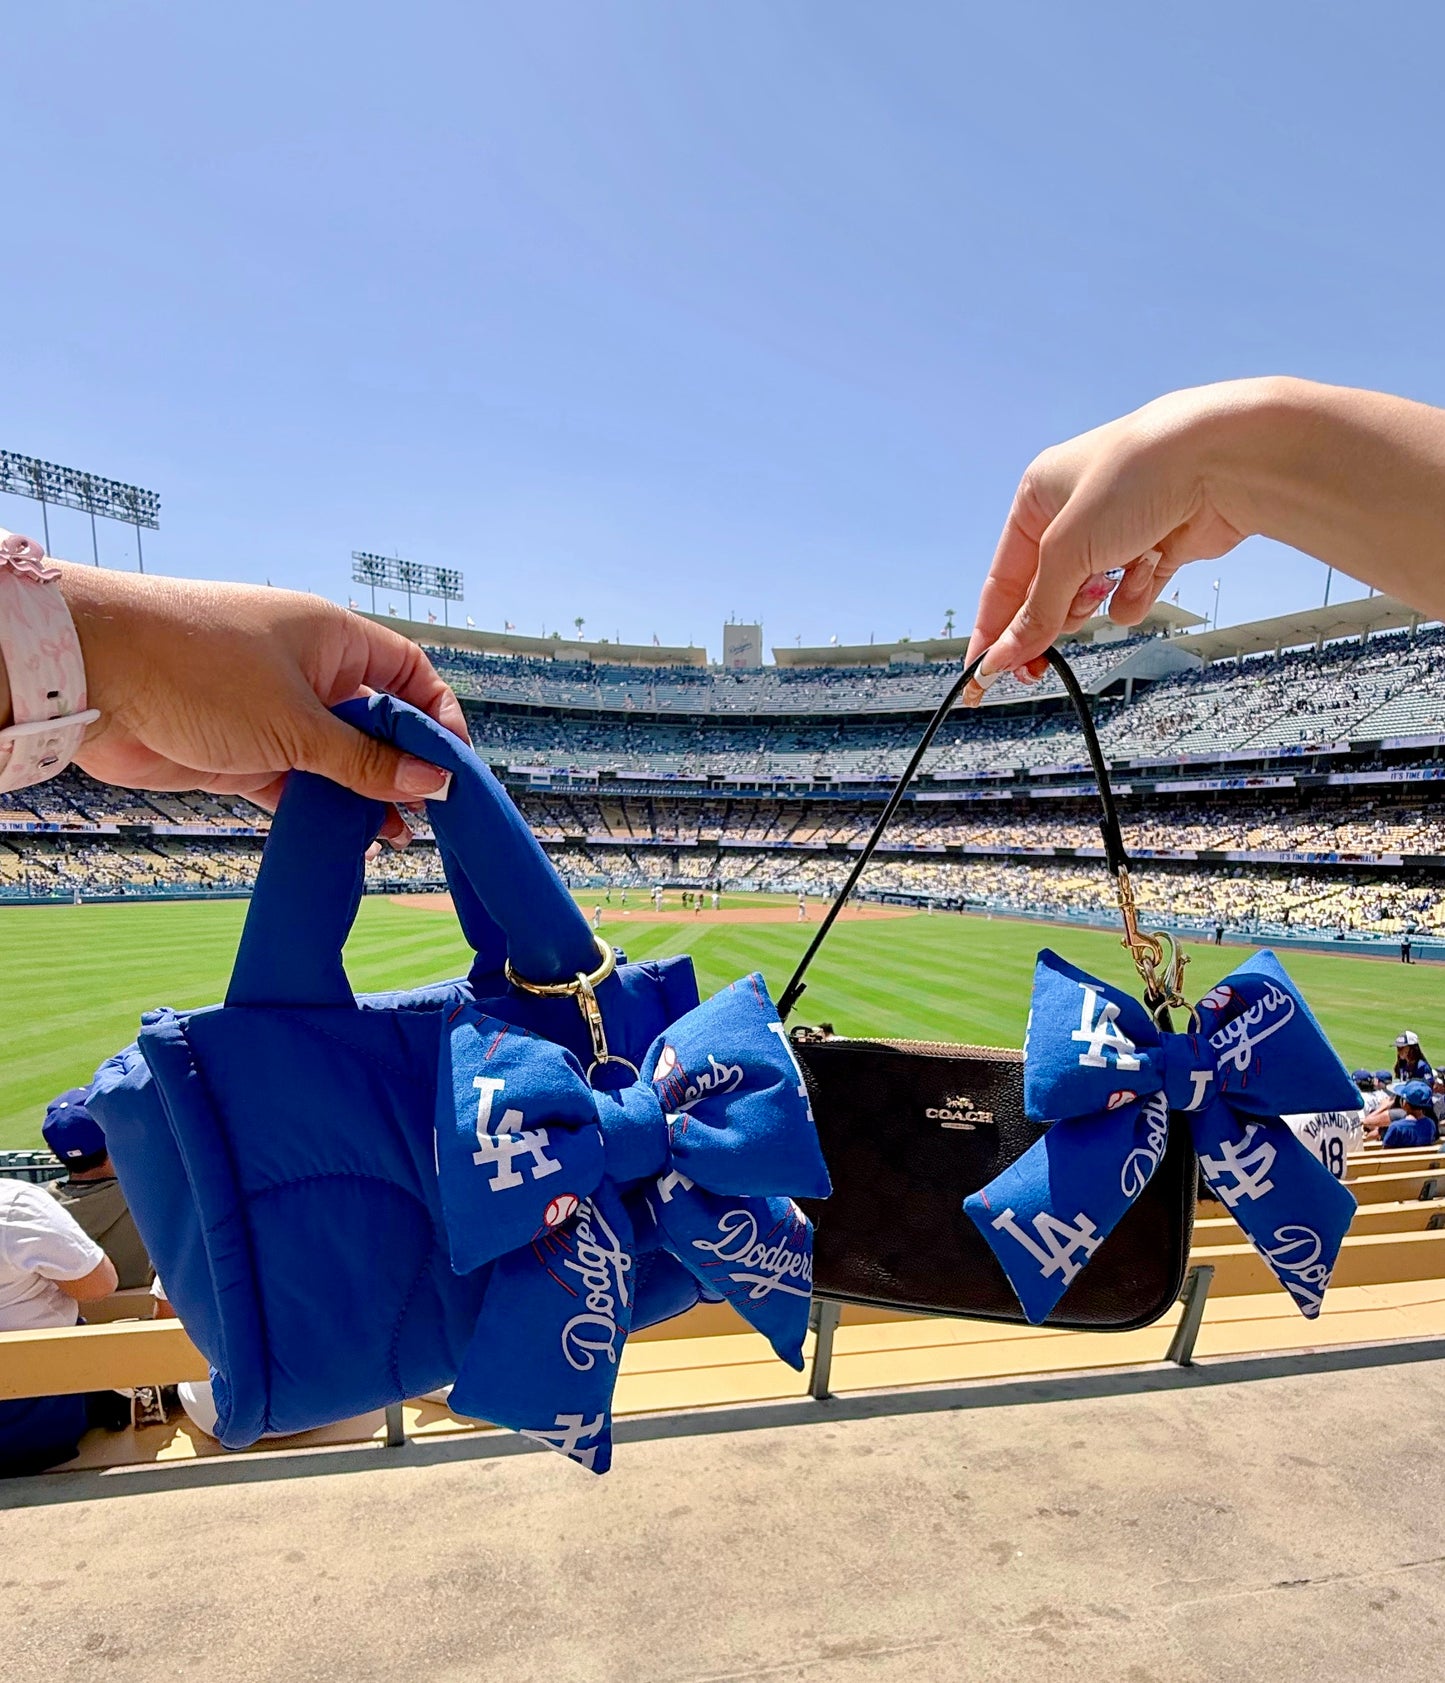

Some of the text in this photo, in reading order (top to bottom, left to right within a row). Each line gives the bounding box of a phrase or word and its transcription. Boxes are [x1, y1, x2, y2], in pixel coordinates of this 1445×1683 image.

[1390, 772, 1404, 780] IT'S
[1405, 771, 1421, 779] TIME
[1279, 853, 1291, 861] IT'S
[1292, 853, 1305, 861] TIME
[1071, 982, 1141, 1071] LA
[472, 1076, 562, 1192] LA
[925, 1107, 994, 1124] COACH
[1303, 1112, 1351, 1139] YAMAMOT
[1319, 1136, 1344, 1180] 18
[990, 1207, 1105, 1287] LA
[561, 1196, 632, 1372] Dodger
